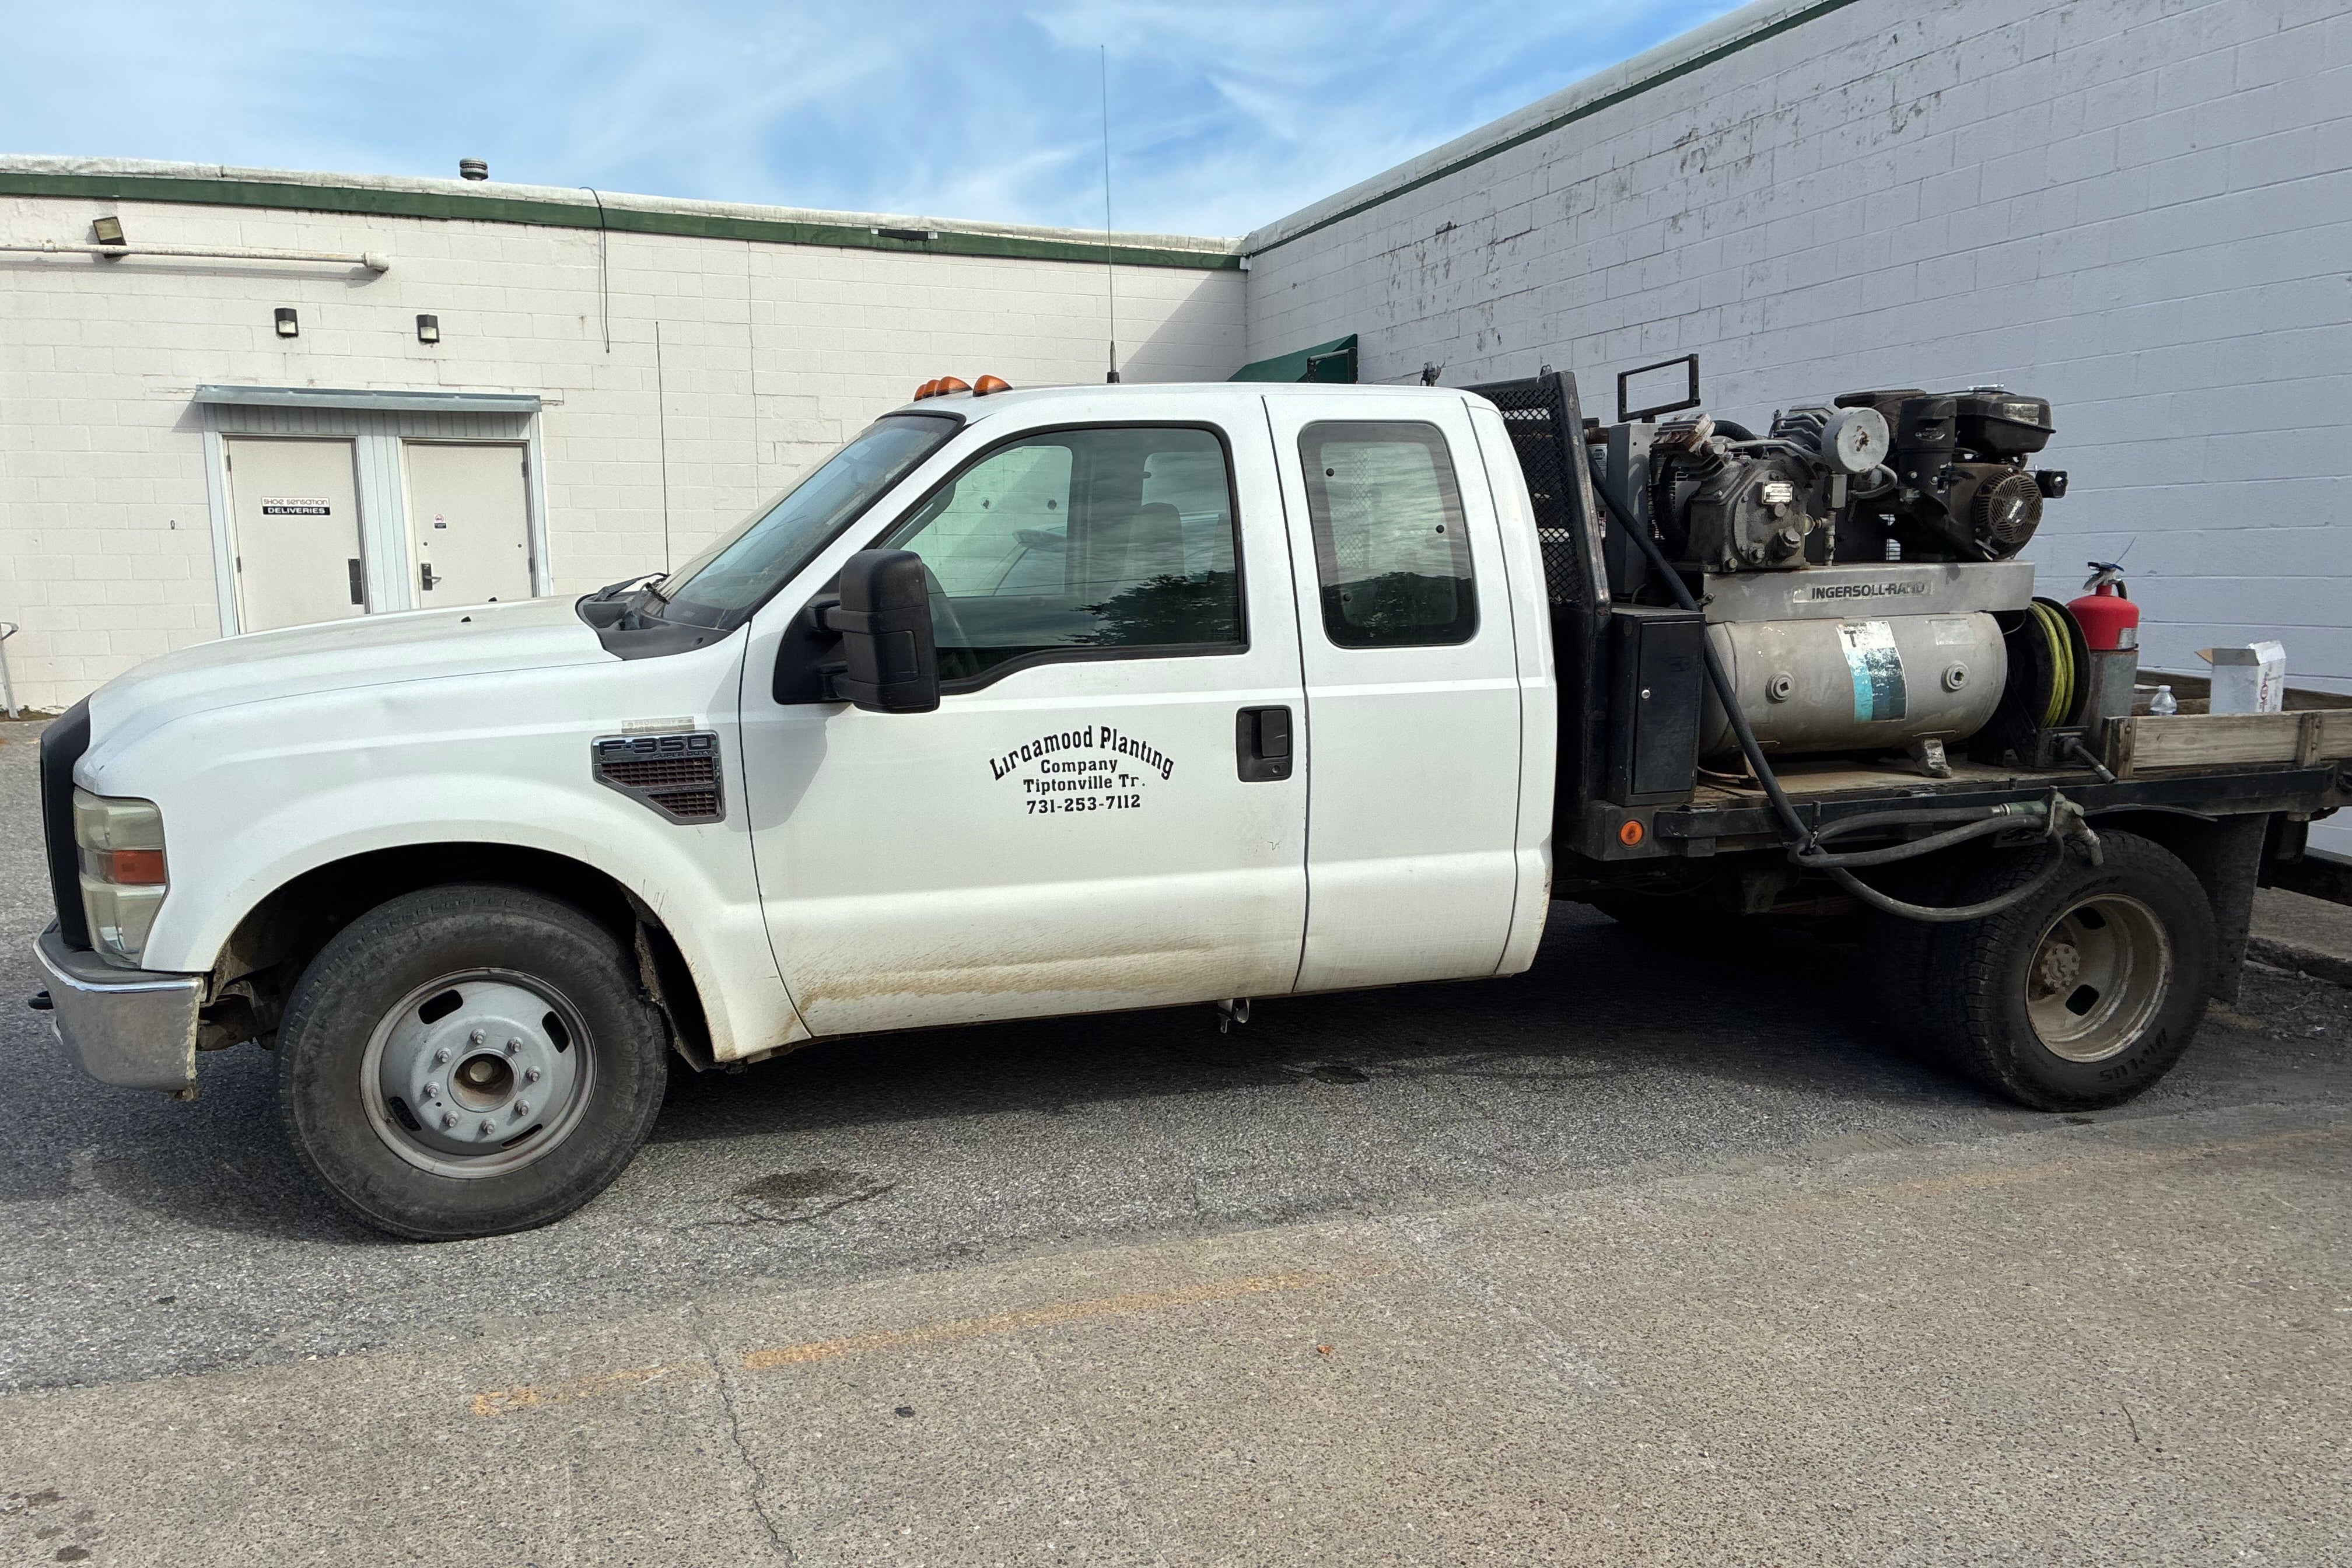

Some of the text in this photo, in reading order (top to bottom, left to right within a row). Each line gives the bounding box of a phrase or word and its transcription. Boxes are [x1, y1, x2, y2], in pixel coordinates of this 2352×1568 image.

[598, 734, 712, 756] F-350
[1100, 726, 1174, 780] Planting
[1041, 759, 1118, 775] Company
[1023, 775, 1112, 796] Tiptonville
[1026, 794, 1140, 814] 731-253-7112
